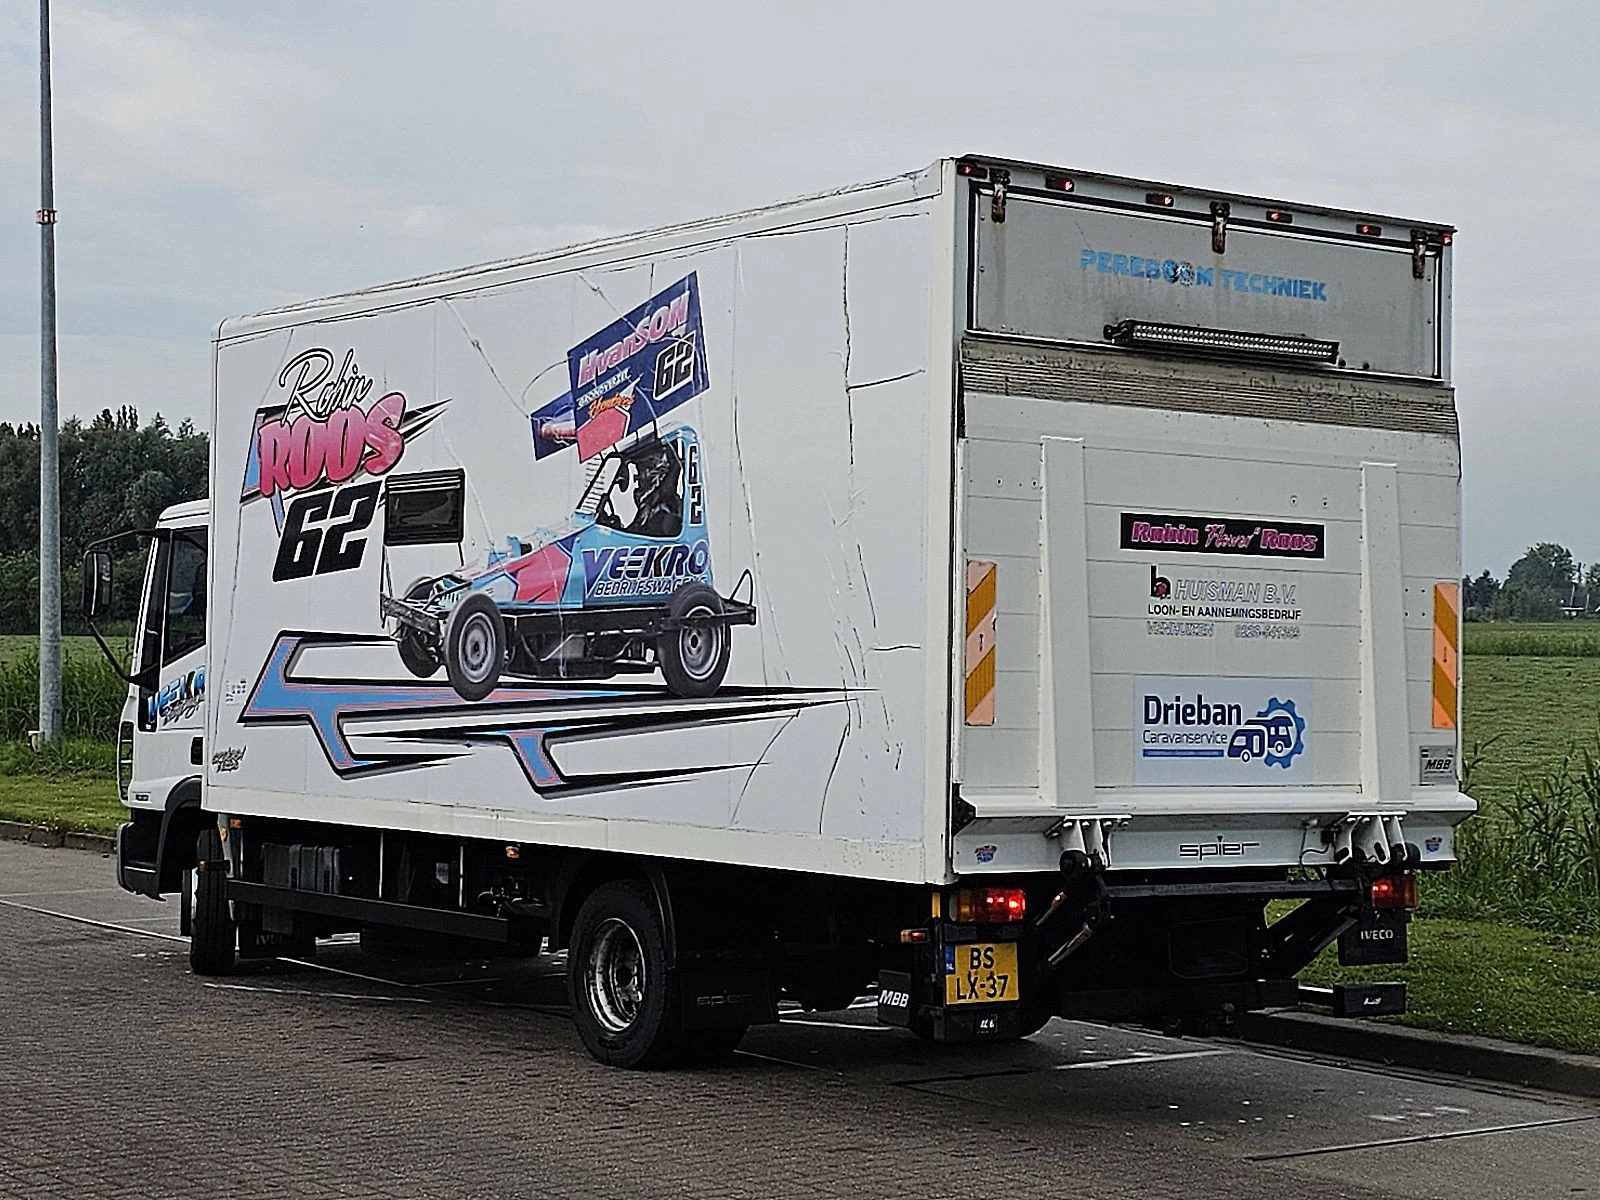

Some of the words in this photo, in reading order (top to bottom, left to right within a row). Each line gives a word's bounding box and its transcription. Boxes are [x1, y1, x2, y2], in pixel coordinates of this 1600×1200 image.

[1221, 268, 1327, 301] TECHNIEK
[654, 331, 696, 400] 62
[279, 348, 373, 422] Robin
[258, 392, 406, 497] ROOS
[273, 480, 383, 582] 62
[1131, 521, 1199, 545] Robin
[1260, 528, 1319, 552] Roos
[582, 540, 709, 597] VEEKRO
[1175, 579, 1260, 603] HUISMAN
[1263, 583, 1297, 605] B.V.
[1148, 604, 1180, 616] LOON-
[1182, 605, 1195, 617] EN
[1197, 606, 1302, 621] AANNEMINGSBEDRIJF
[1144, 694, 1242, 726] Drieban
[1143, 730, 1228, 744] Caravanservice
[1425, 759, 1452, 770] MBB
[1179, 835, 1260, 861] spier
[1361, 929, 1394, 940] IVECO
[970, 947, 994, 970] BS
[879, 989, 910, 1008] MBB
[956, 973, 1009, 1000] LX-37
